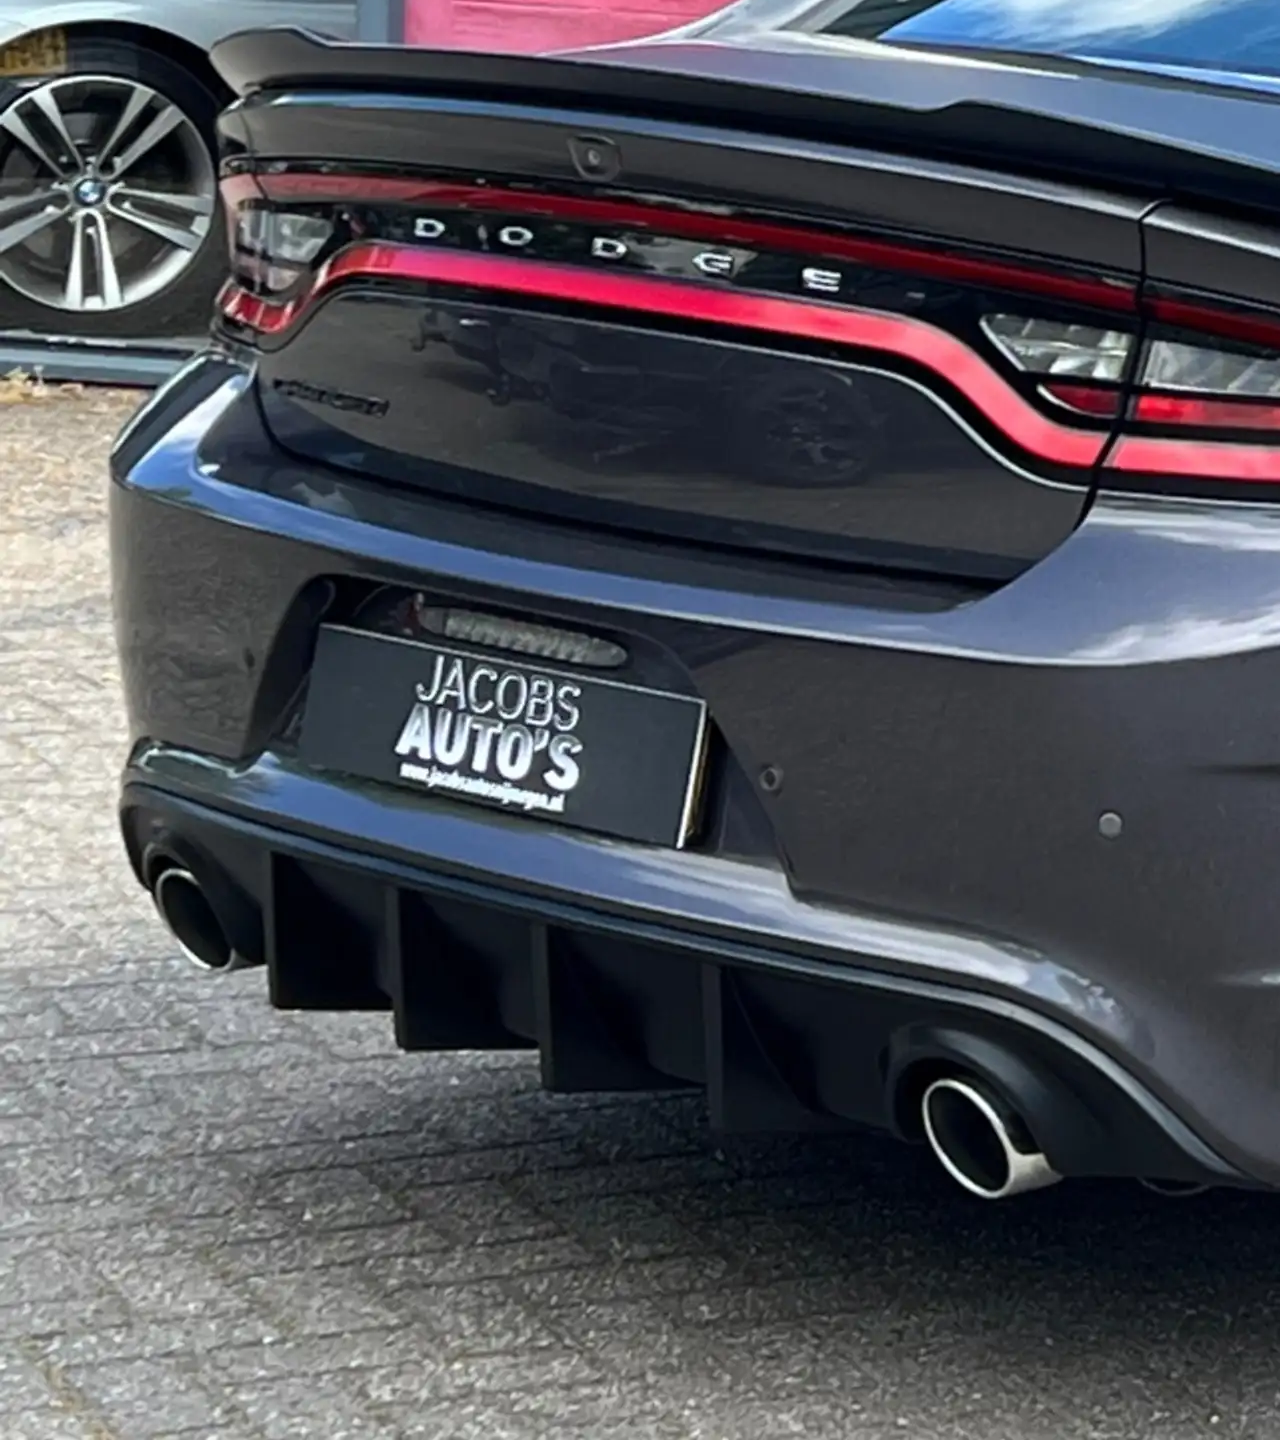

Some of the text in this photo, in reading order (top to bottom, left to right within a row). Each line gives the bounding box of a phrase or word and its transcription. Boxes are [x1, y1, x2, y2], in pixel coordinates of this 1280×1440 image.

[413, 217, 842, 292] DODGE
[415, 655, 582, 731] JACOBS
[394, 701, 584, 792] AUTO'S
